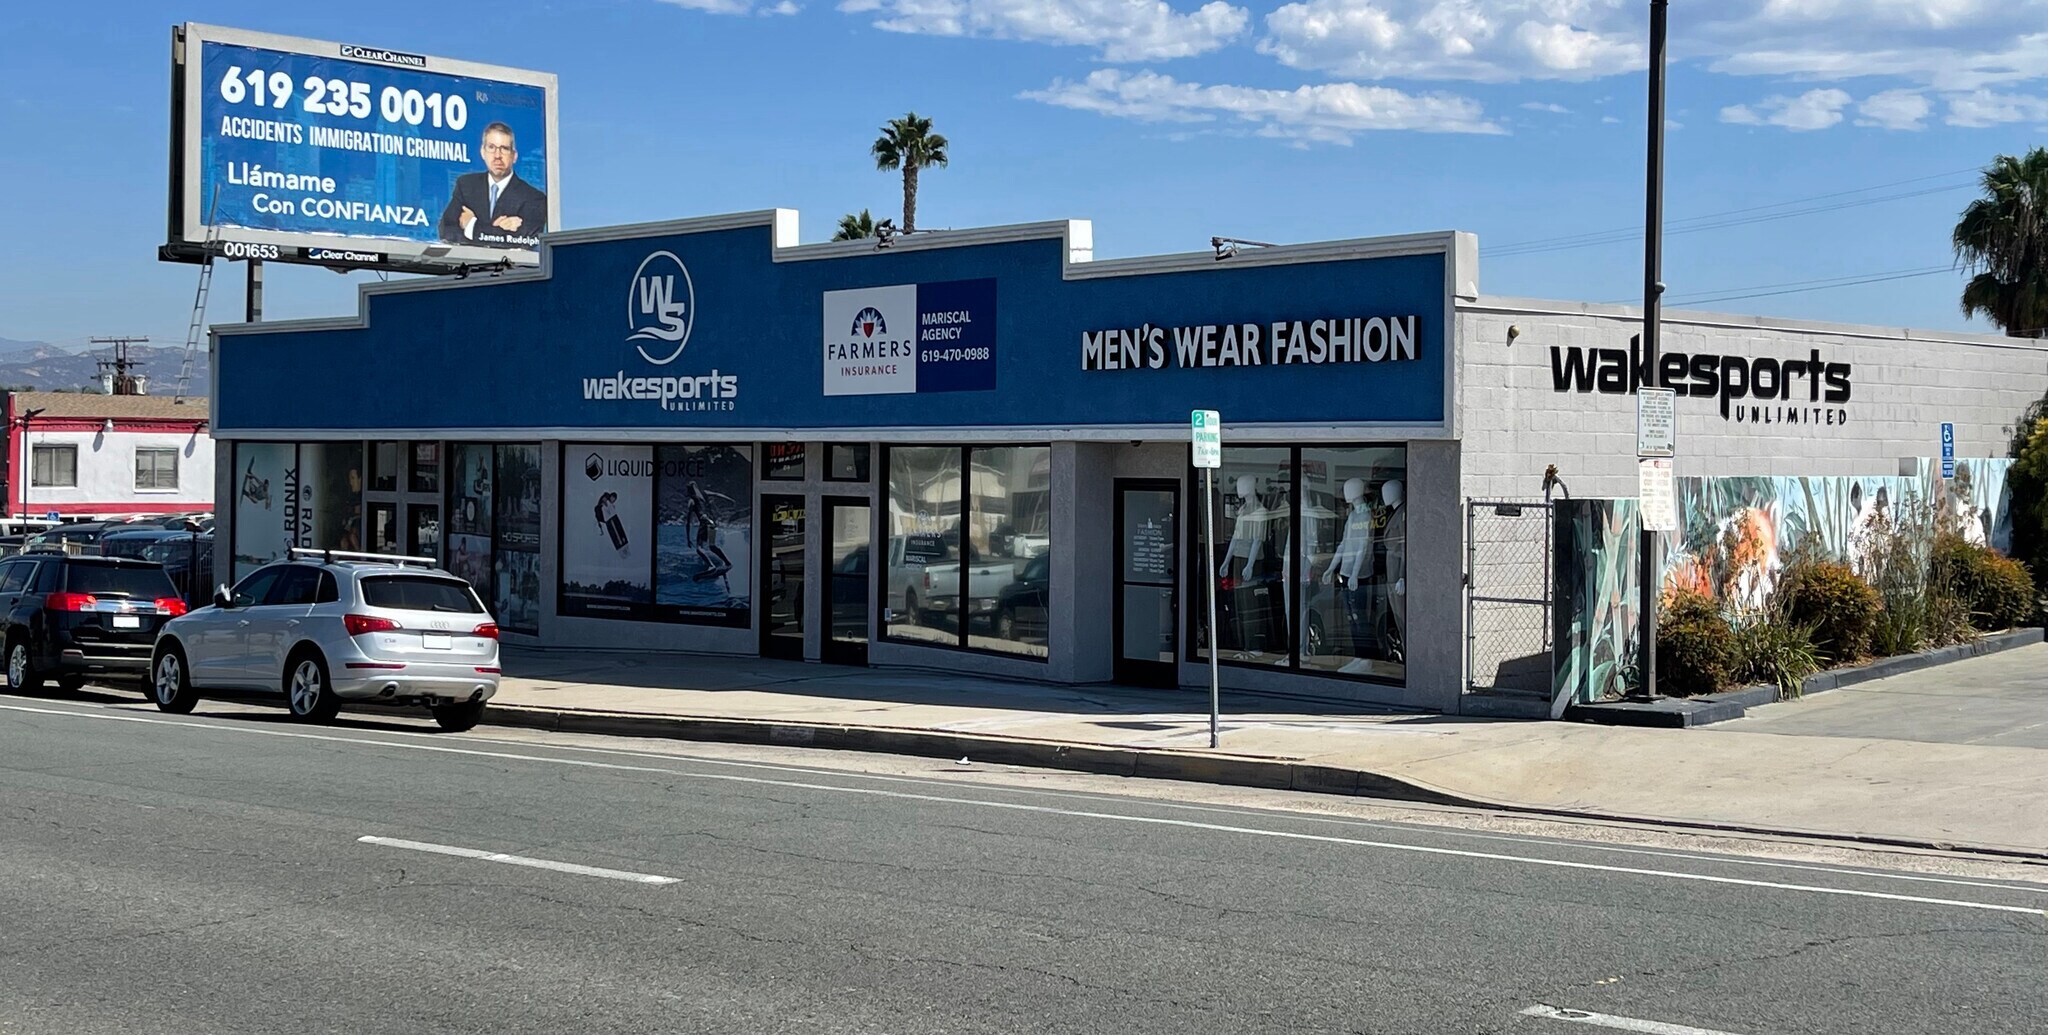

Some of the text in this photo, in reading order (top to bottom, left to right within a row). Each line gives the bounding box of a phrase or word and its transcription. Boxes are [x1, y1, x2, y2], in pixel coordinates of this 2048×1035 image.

[220, 66, 468, 131] 619 235 0010
[220, 115, 471, 164] ACCIDENTS IMMIGRATION CRIMINAL
[228, 162, 336, 194] Llámame
[252, 194, 429, 227] Con CONFIANZA
[223, 241, 279, 259] 001653
[478, 232, 540, 247] James Rudolph
[321, 249, 379, 262] Clear Channel
[921, 310, 972, 326] MARISCAL
[921, 327, 962, 342] AGENCY
[1081, 315, 1417, 371] MEN'S WEAR FASHION
[828, 339, 912, 362] FARMERS
[921, 346, 990, 363] 619-470-0988
[841, 364, 898, 377] INSURANCE
[583, 369, 738, 411] wakesports
[669, 400, 735, 412] UNLIMITED
[1736, 404, 1848, 426] UNLIMITED
[1195, 413, 1203, 426] 2
[284, 468, 297, 532] RONIX
[301, 508, 313, 557] RAD
